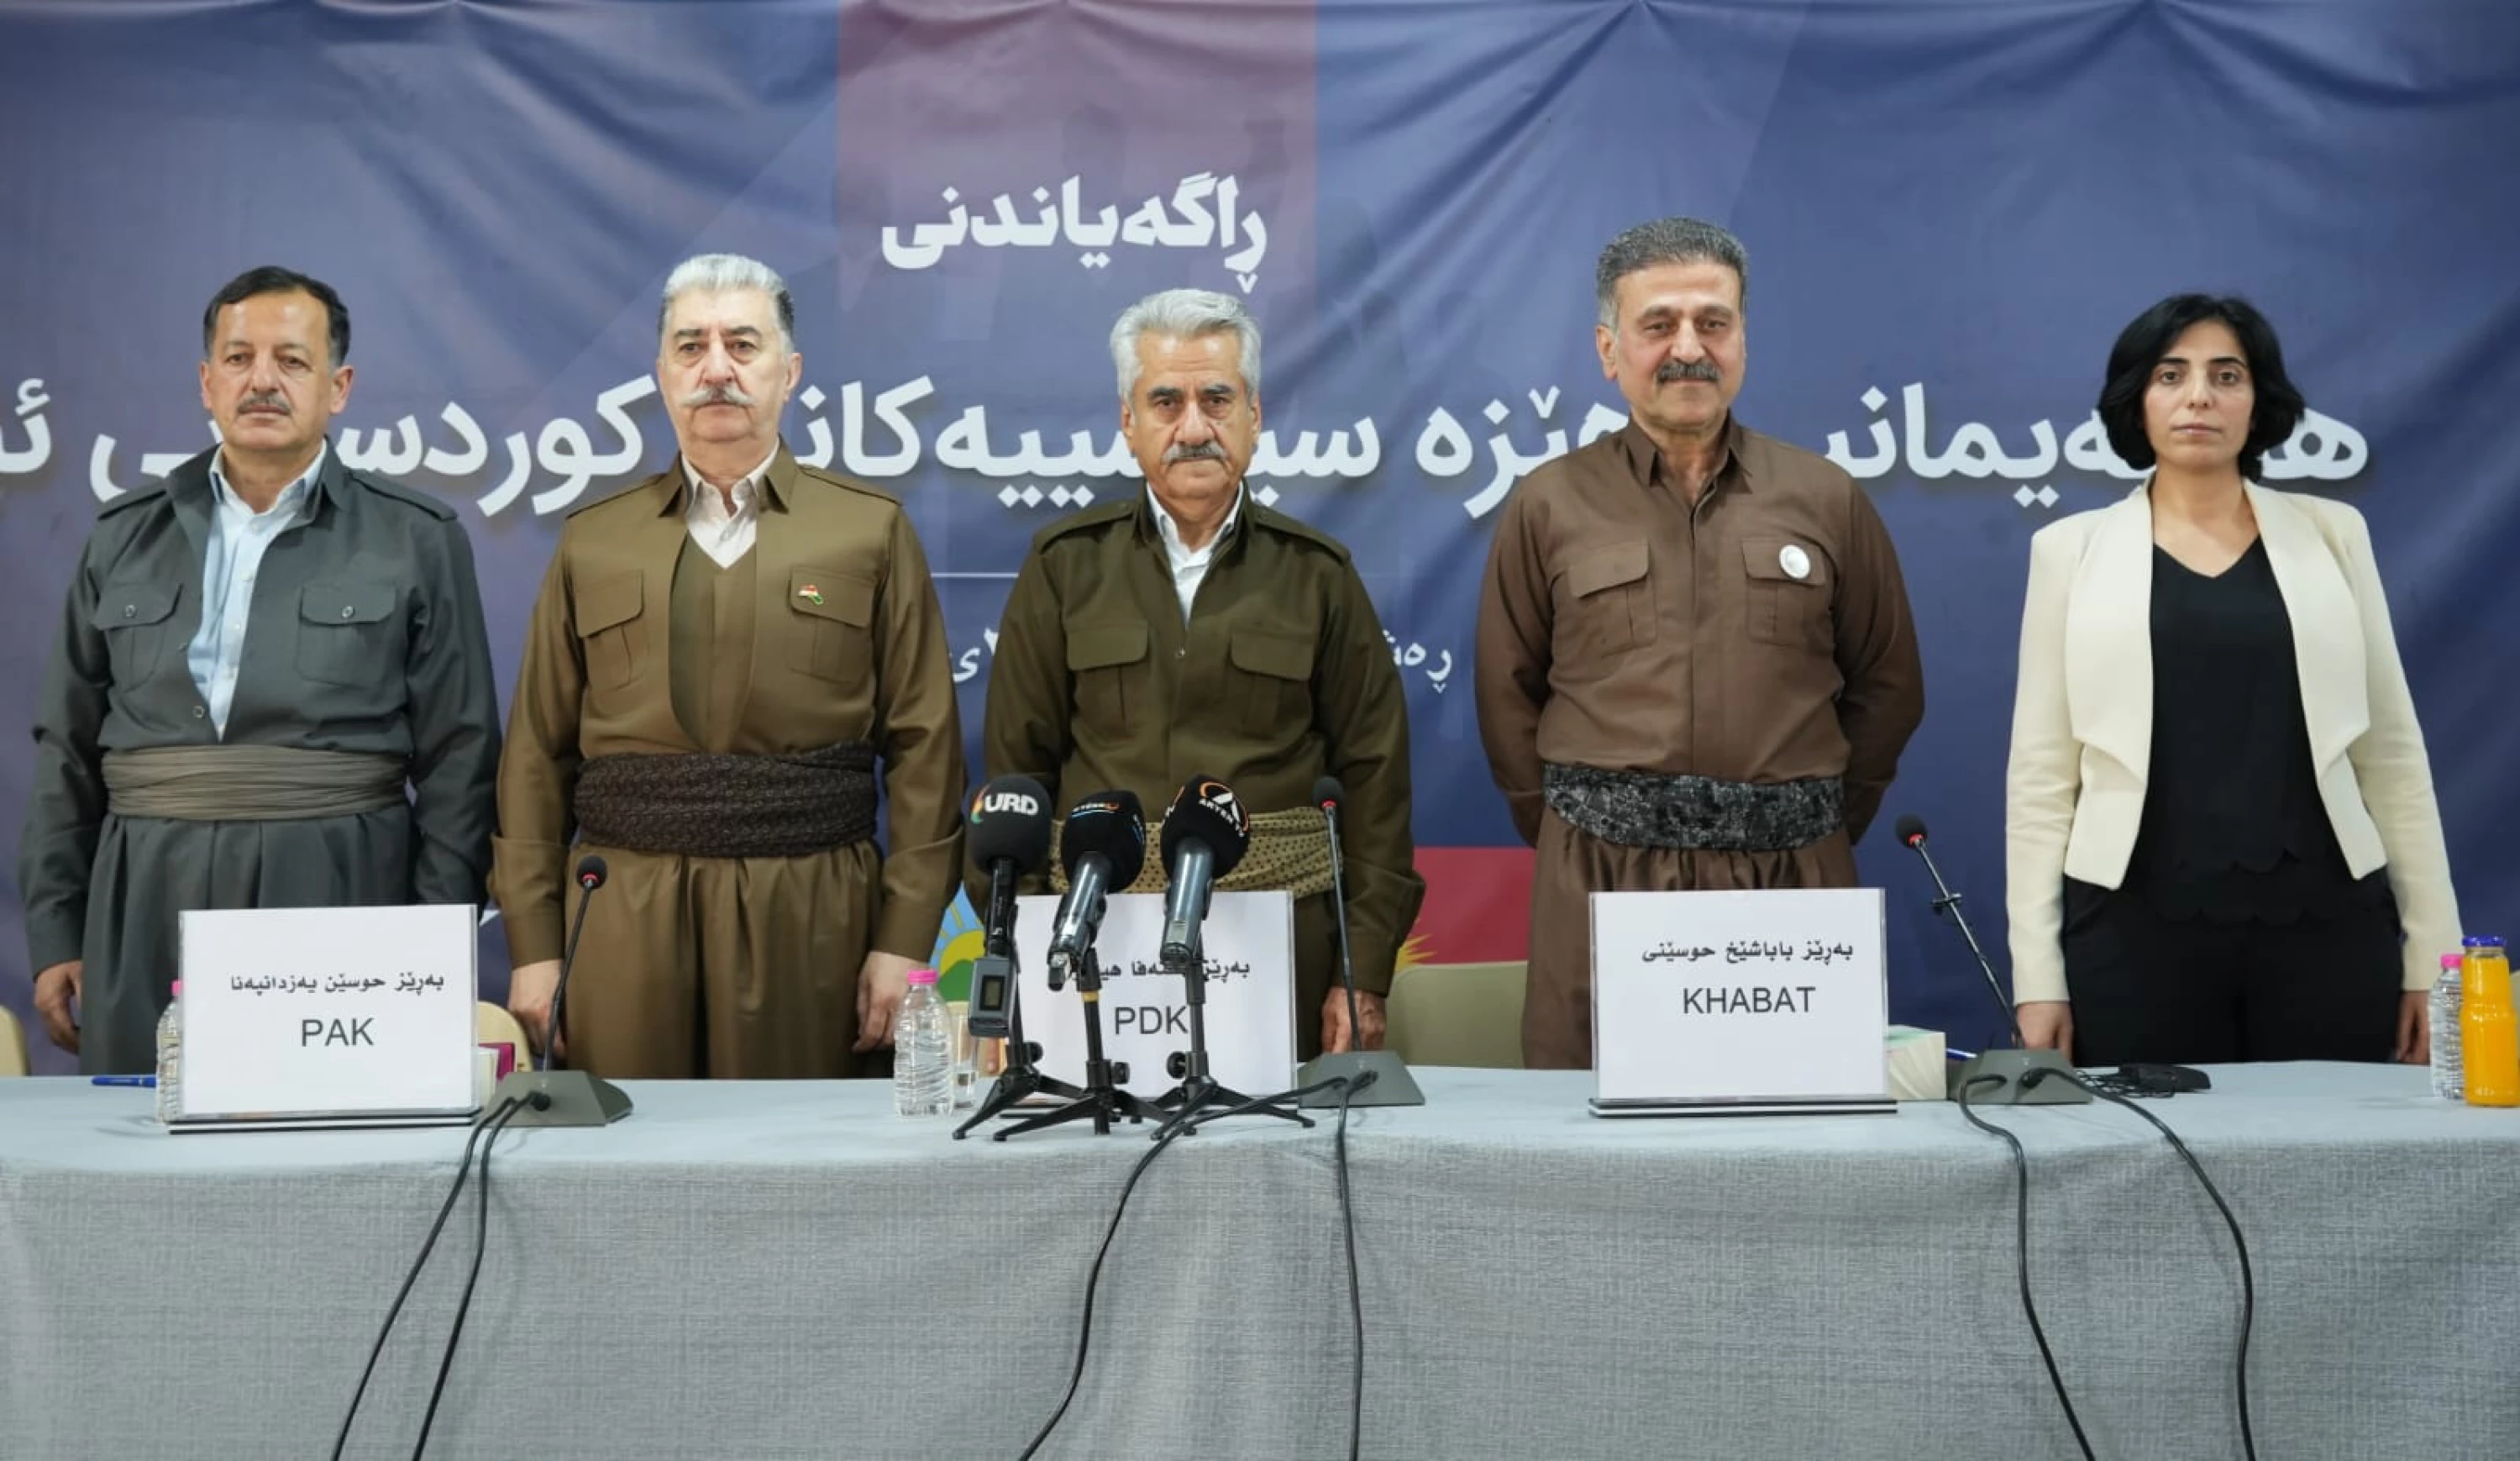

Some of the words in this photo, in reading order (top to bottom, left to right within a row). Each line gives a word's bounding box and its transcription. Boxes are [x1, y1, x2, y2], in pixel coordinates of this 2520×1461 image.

[882, 172, 1267, 294] ڕاگەیاندنی
[1641, 941, 1715, 962] حوسێنی
[1802, 939, 1853, 966] بەڕێز
[324, 973, 386, 993] حوسێن
[394, 970, 444, 996] بەڕێز
[1683, 985, 1816, 1014] KHABAT
[302, 1017, 375, 1047] PAK
[1115, 1006, 1189, 1035] PDK
